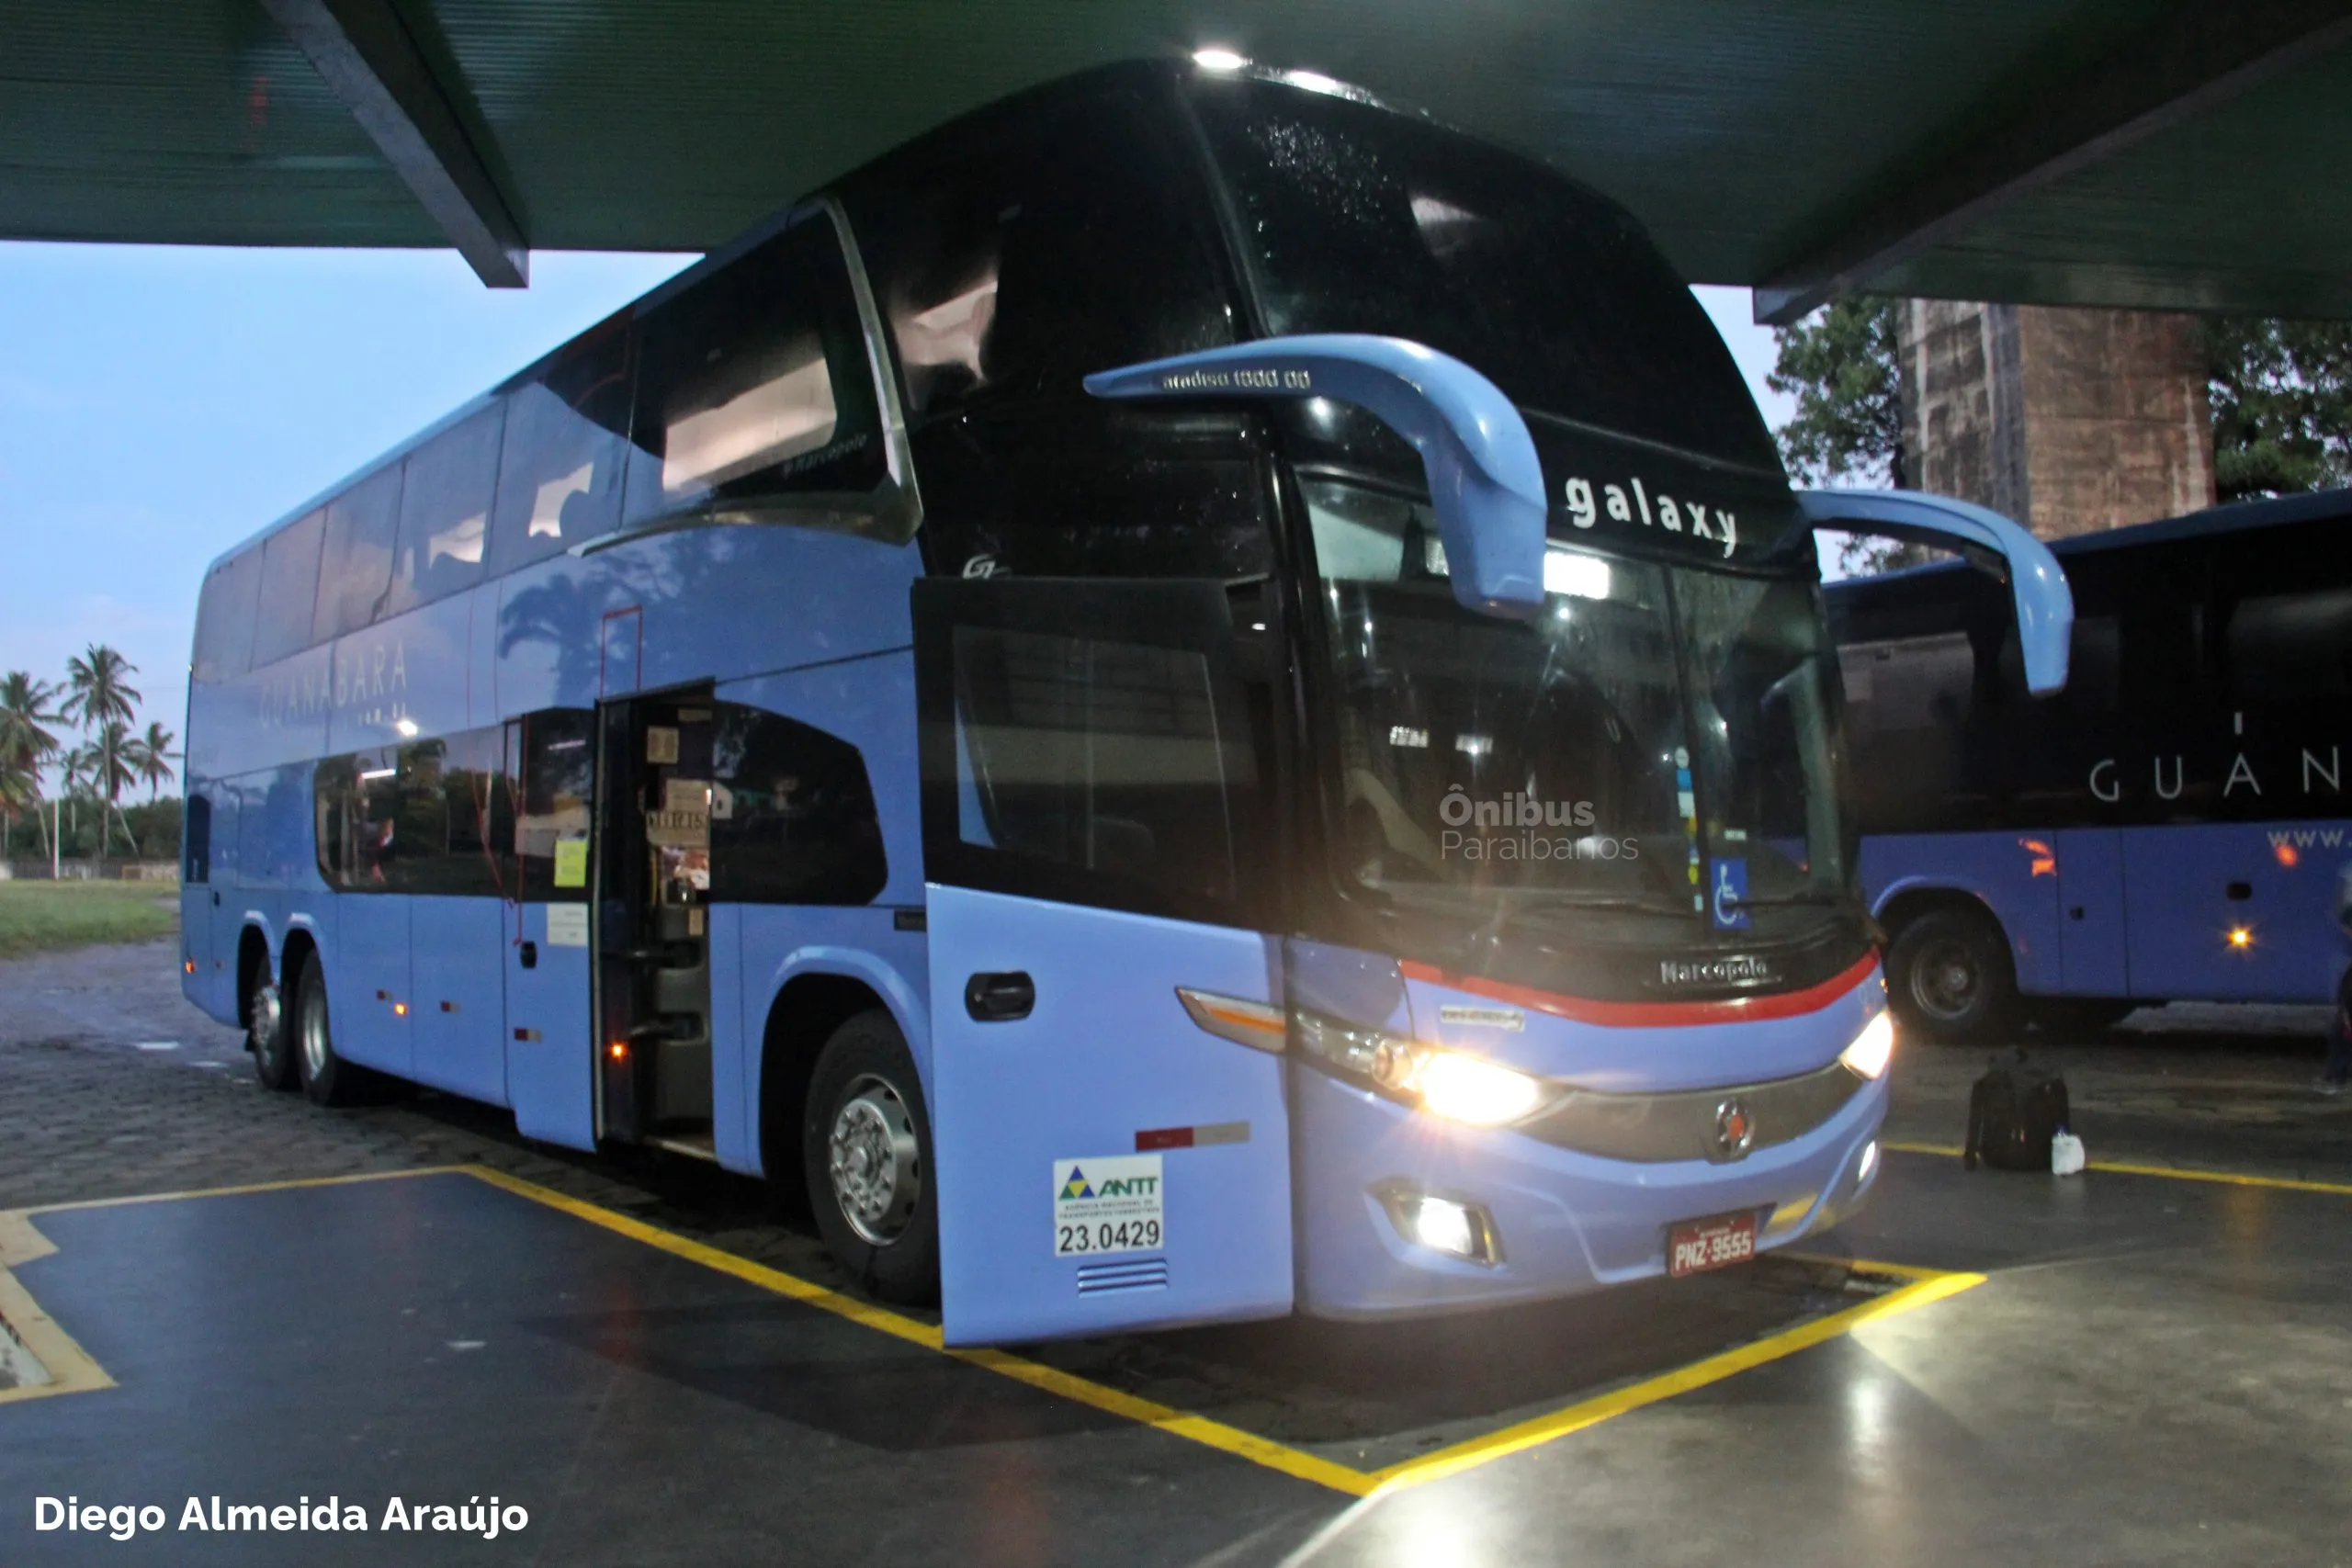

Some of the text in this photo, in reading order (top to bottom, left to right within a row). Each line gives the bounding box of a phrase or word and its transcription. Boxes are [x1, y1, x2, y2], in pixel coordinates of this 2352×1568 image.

[1565, 476, 1736, 558] galaxy
[1099, 1176, 1159, 1197] ANTT
[1059, 1220, 1160, 1252] 23.0429
